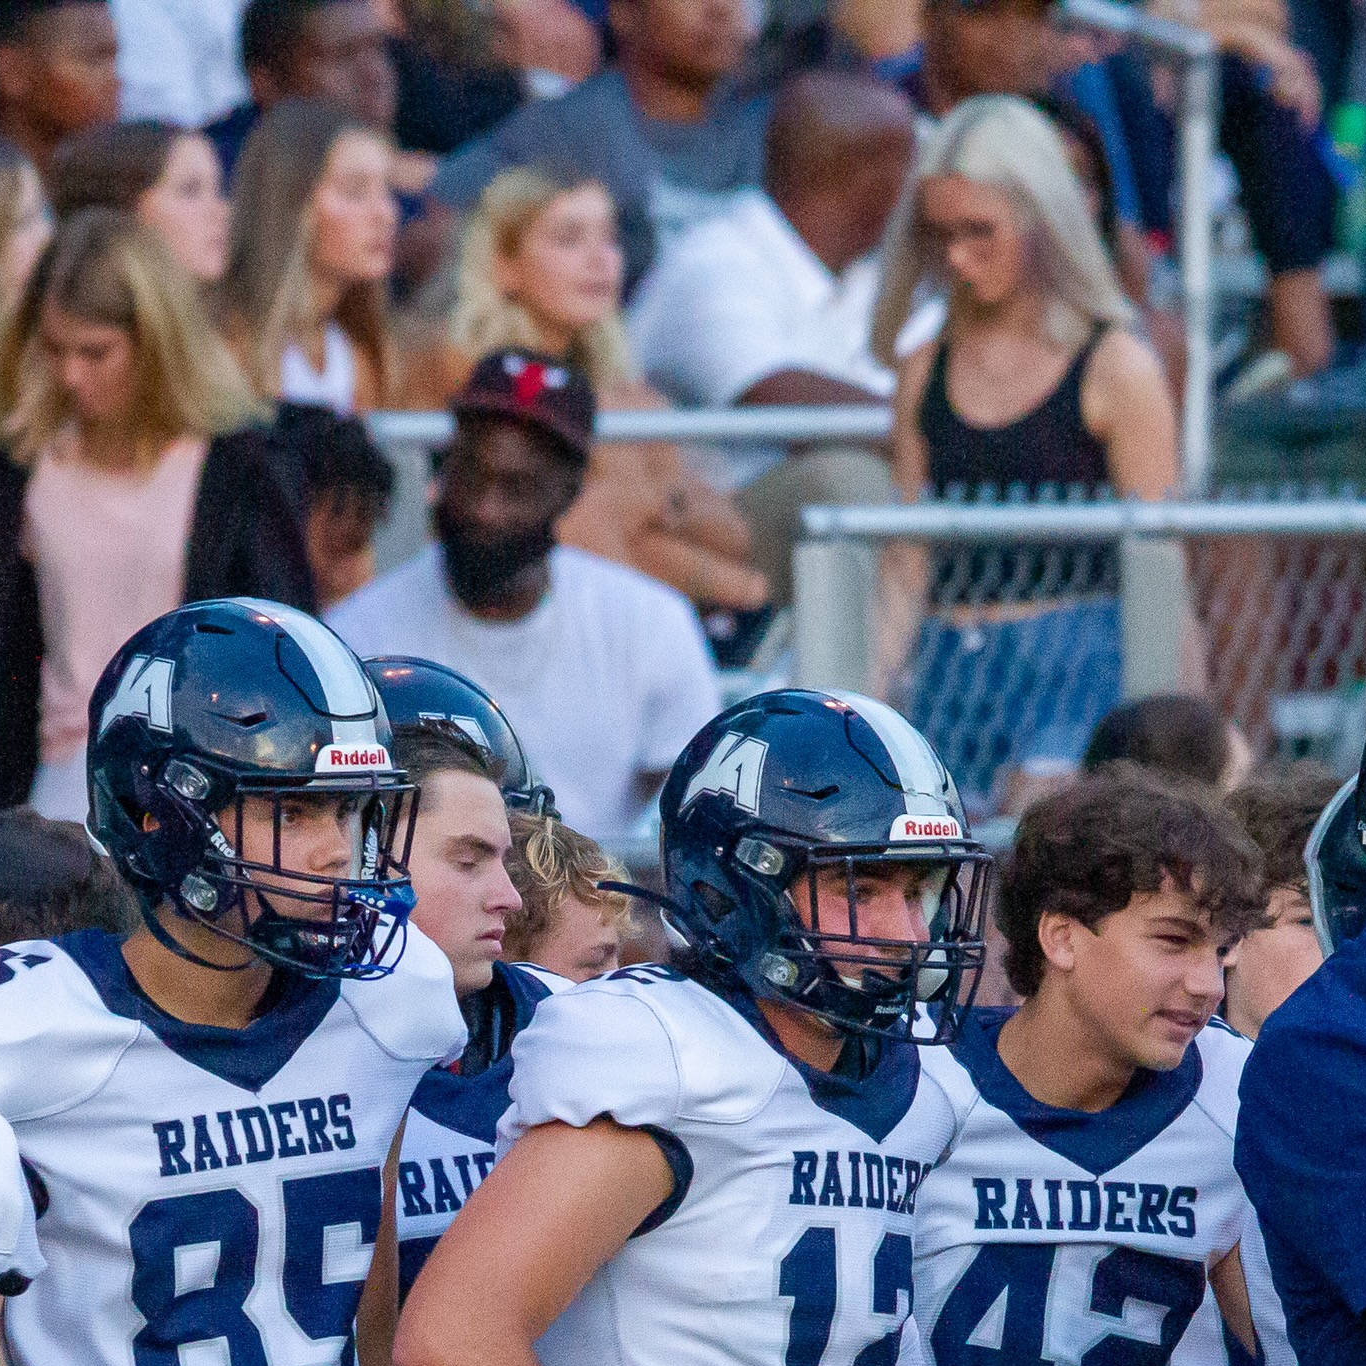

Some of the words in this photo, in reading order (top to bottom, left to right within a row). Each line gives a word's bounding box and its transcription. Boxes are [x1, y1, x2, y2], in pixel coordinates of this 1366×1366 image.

[330, 749, 385, 766] Riddell
[904, 818, 959, 837] Riddell
[153, 1094, 357, 1177] RAIDERS
[974, 1177, 1197, 1238] RAIDERS
